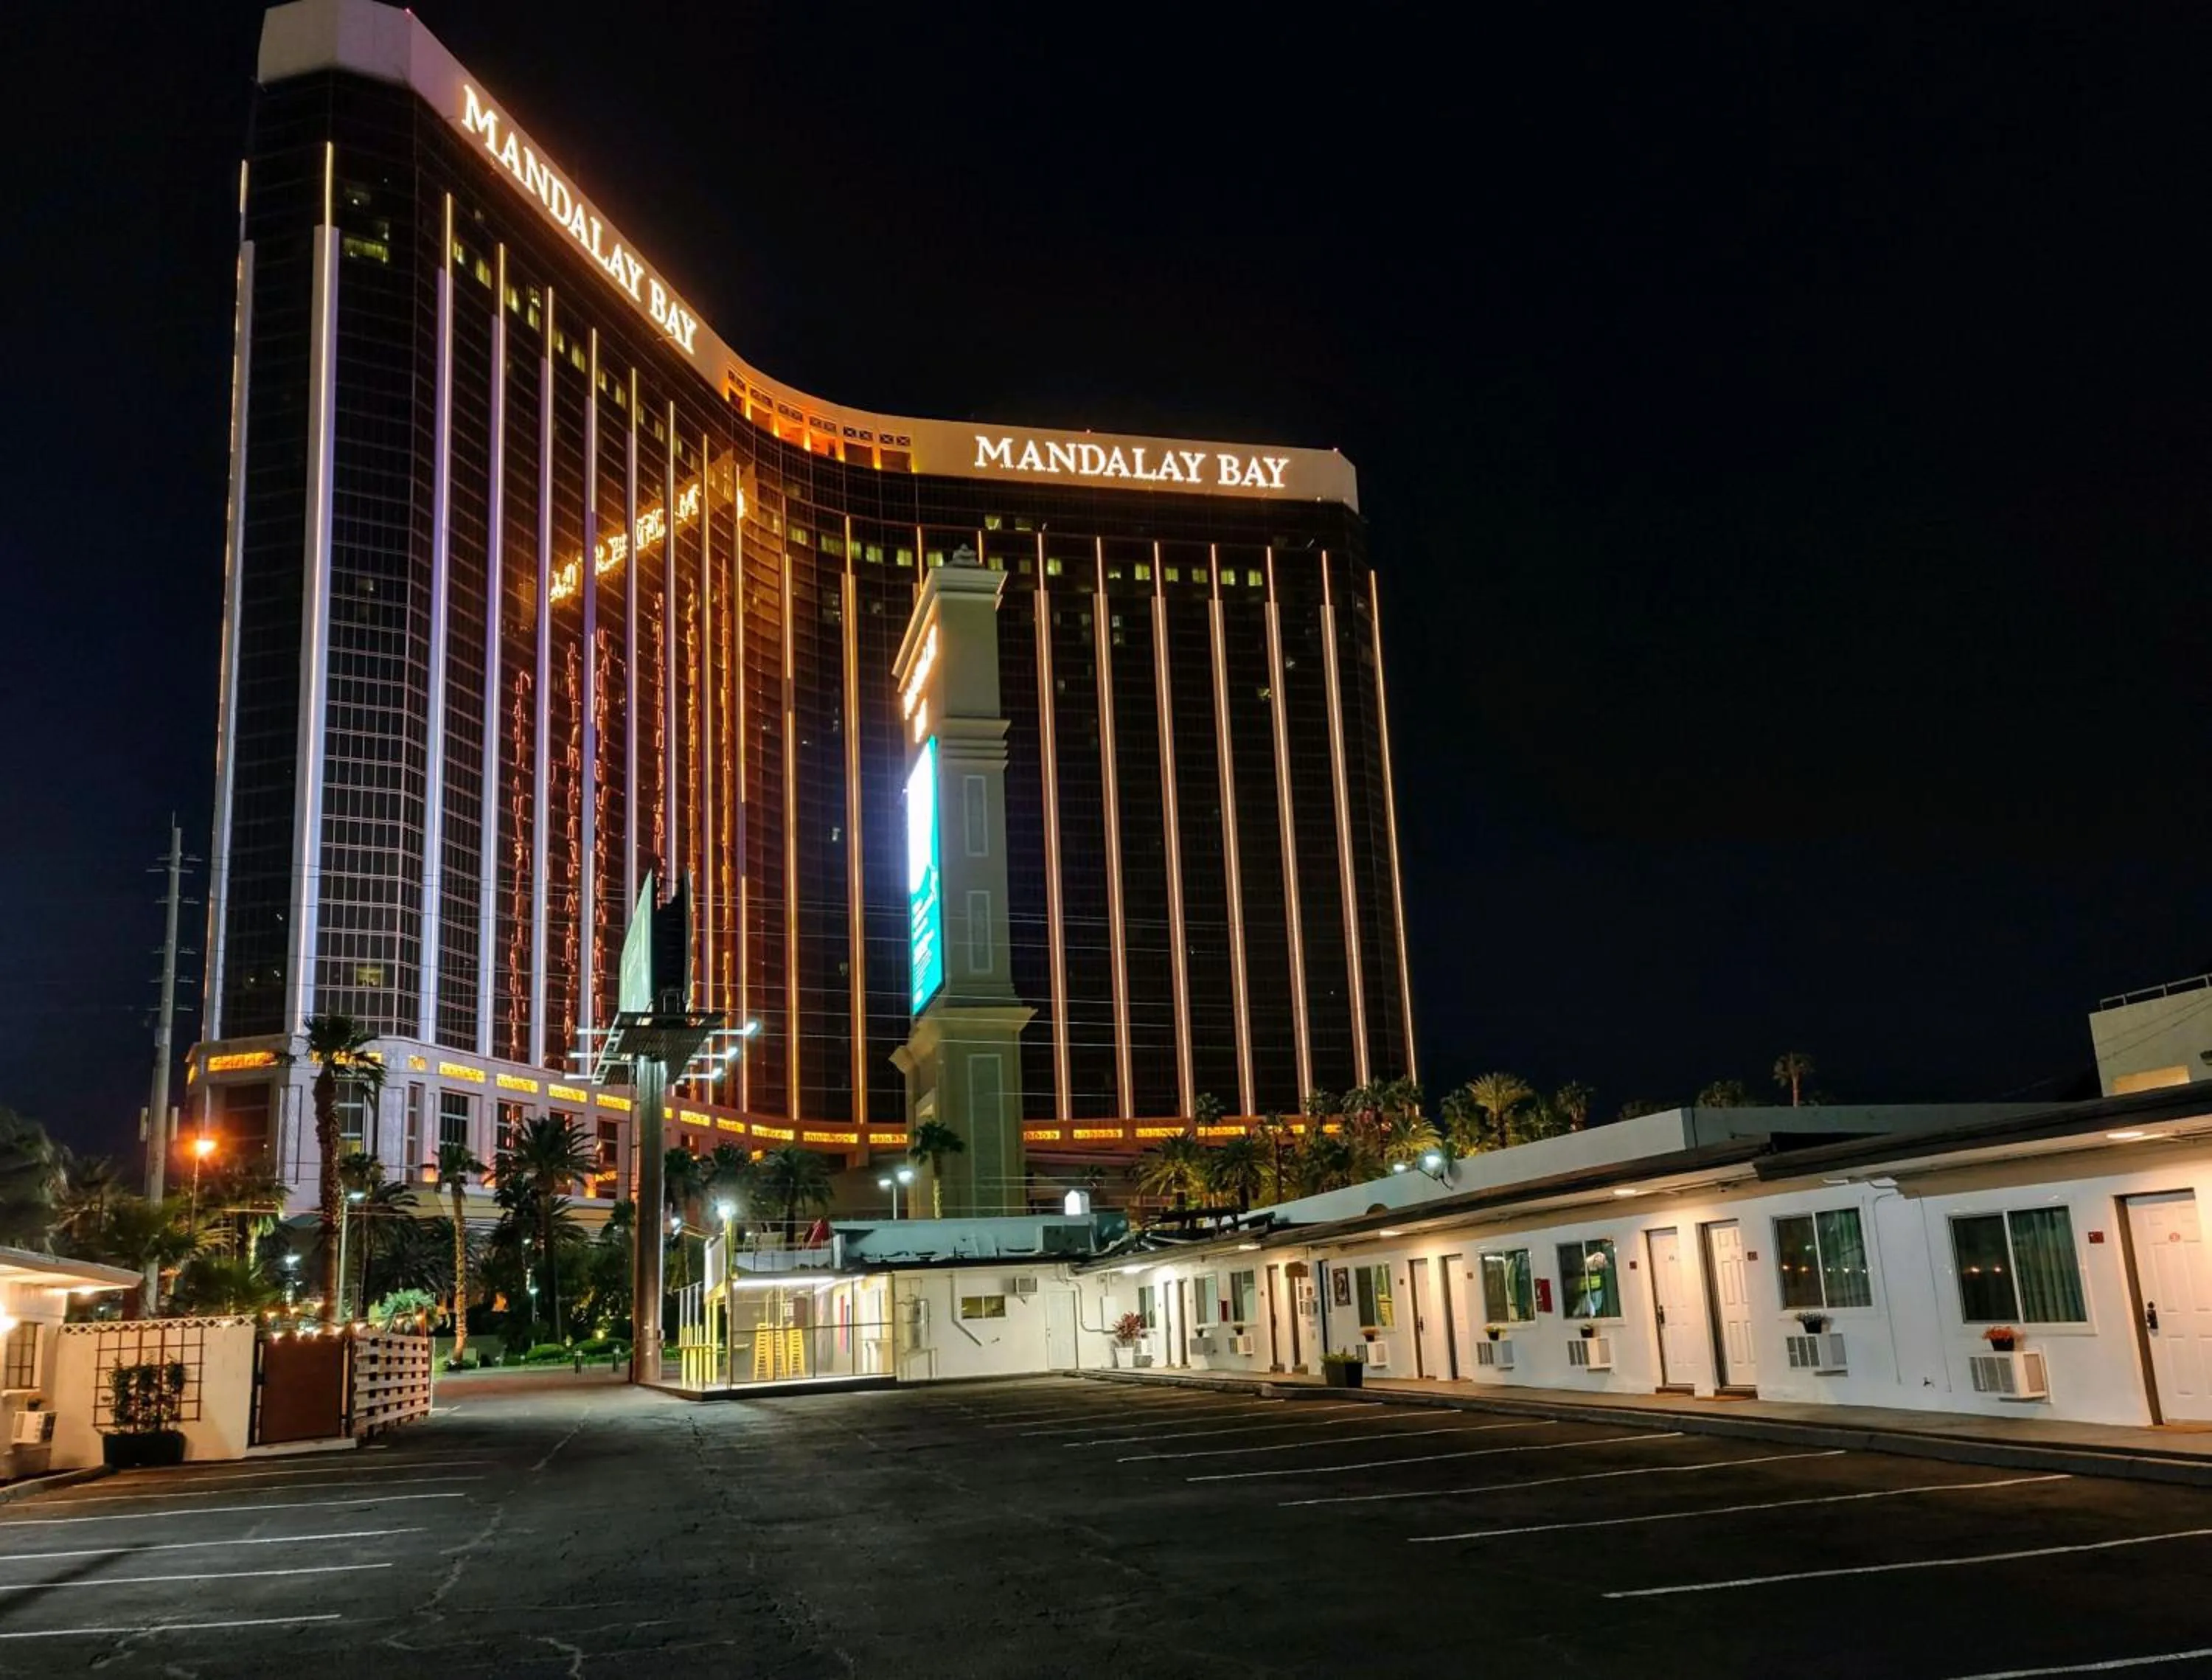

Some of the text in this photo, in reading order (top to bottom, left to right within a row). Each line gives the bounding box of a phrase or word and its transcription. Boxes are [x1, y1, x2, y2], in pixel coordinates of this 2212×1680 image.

[461, 84, 698, 355] MANDALAY BAY
[974, 436, 1290, 487] MANDALAY BAY
